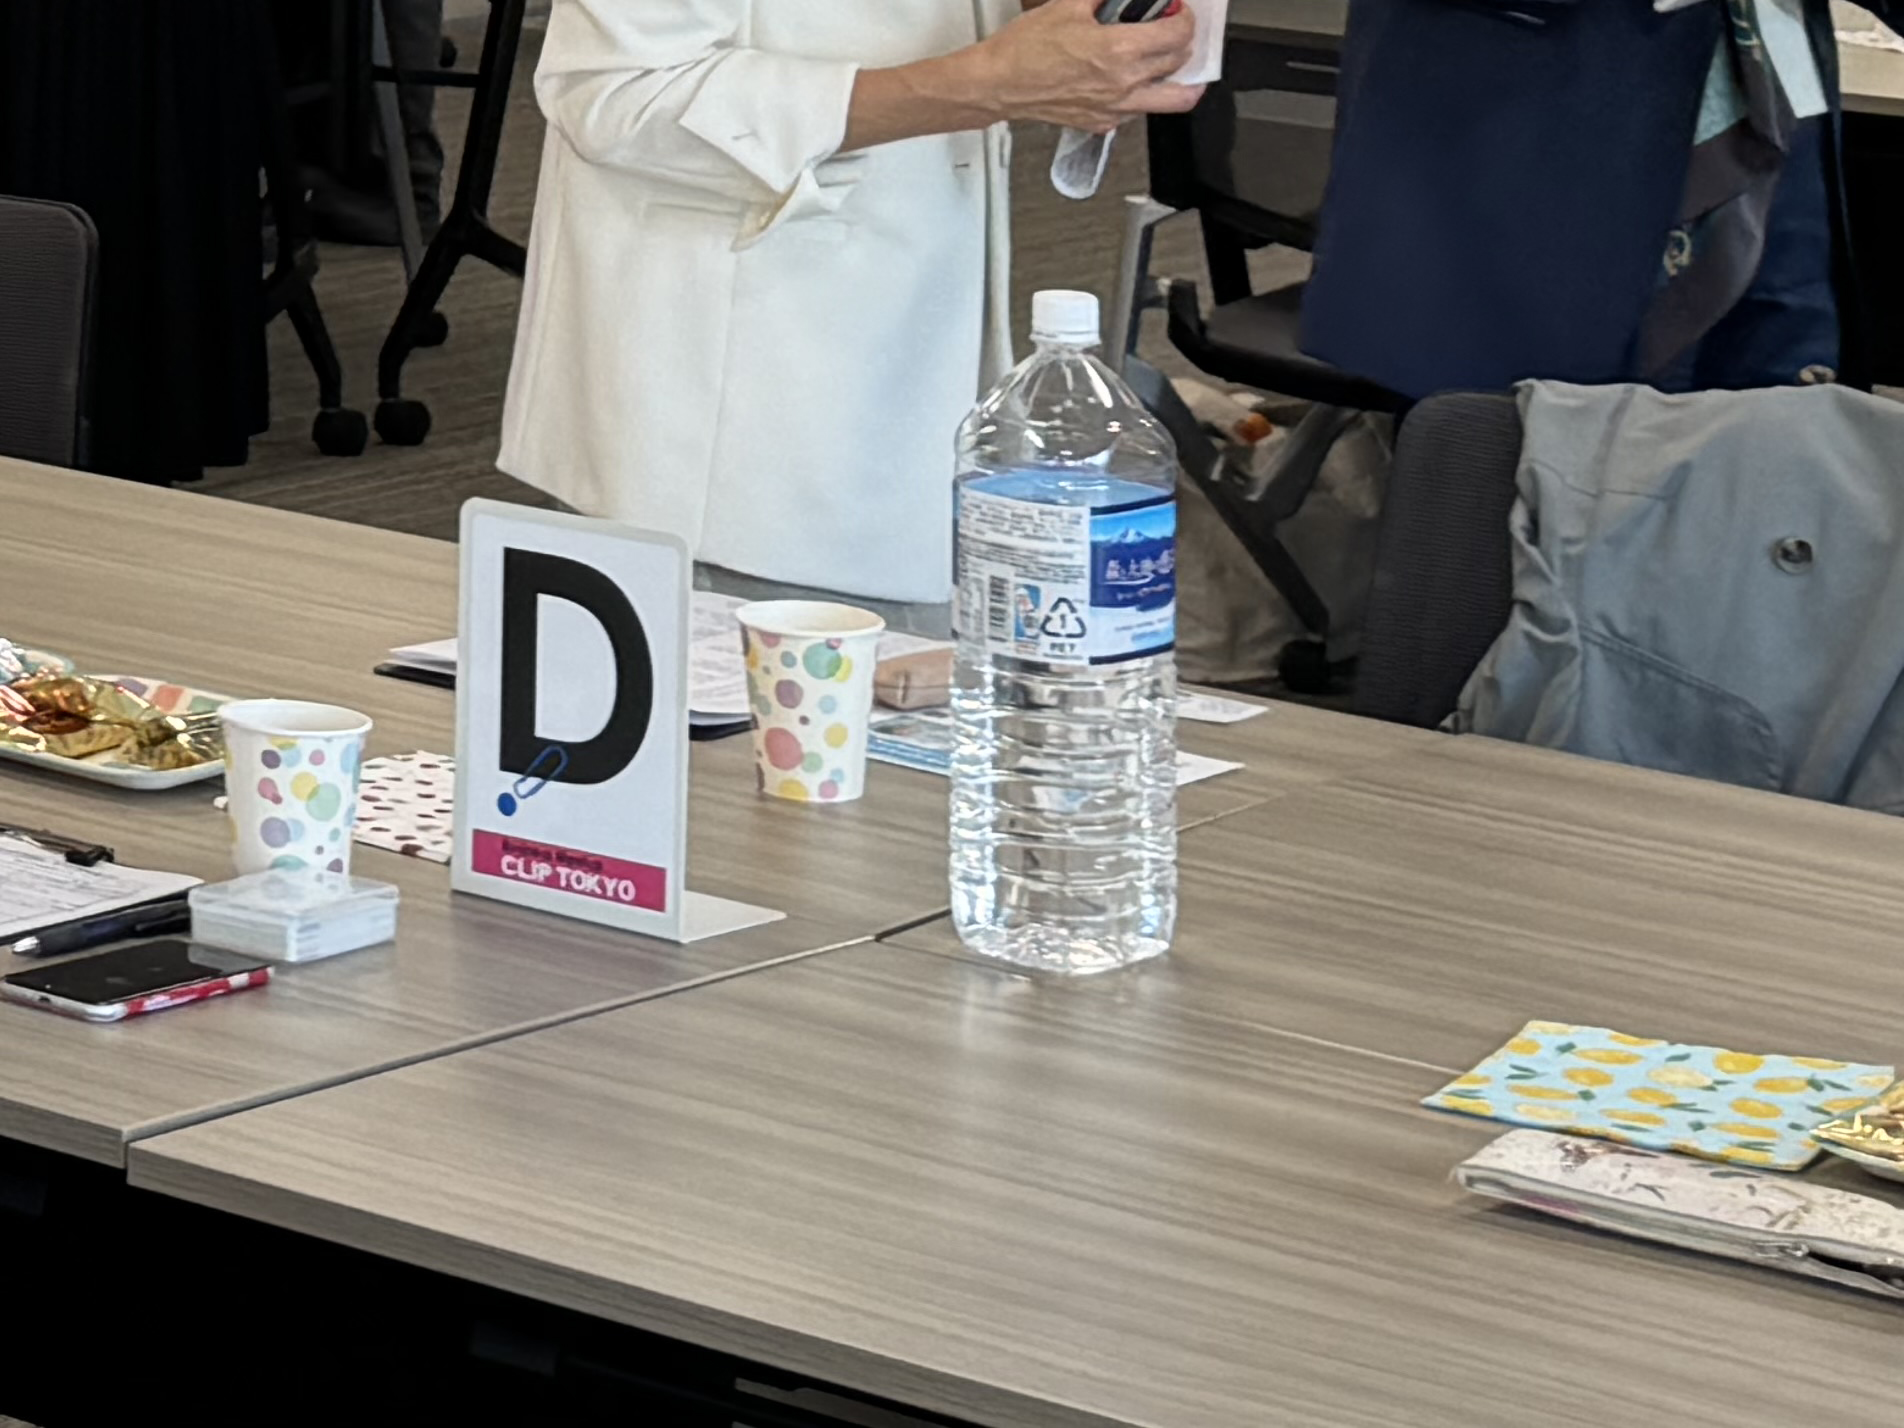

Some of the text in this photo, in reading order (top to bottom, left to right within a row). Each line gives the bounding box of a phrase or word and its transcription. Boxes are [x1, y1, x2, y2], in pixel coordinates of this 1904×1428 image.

[499, 546, 654, 785] D
[500, 854, 553, 883] CLIP
[555, 866, 636, 902] TOKYO
